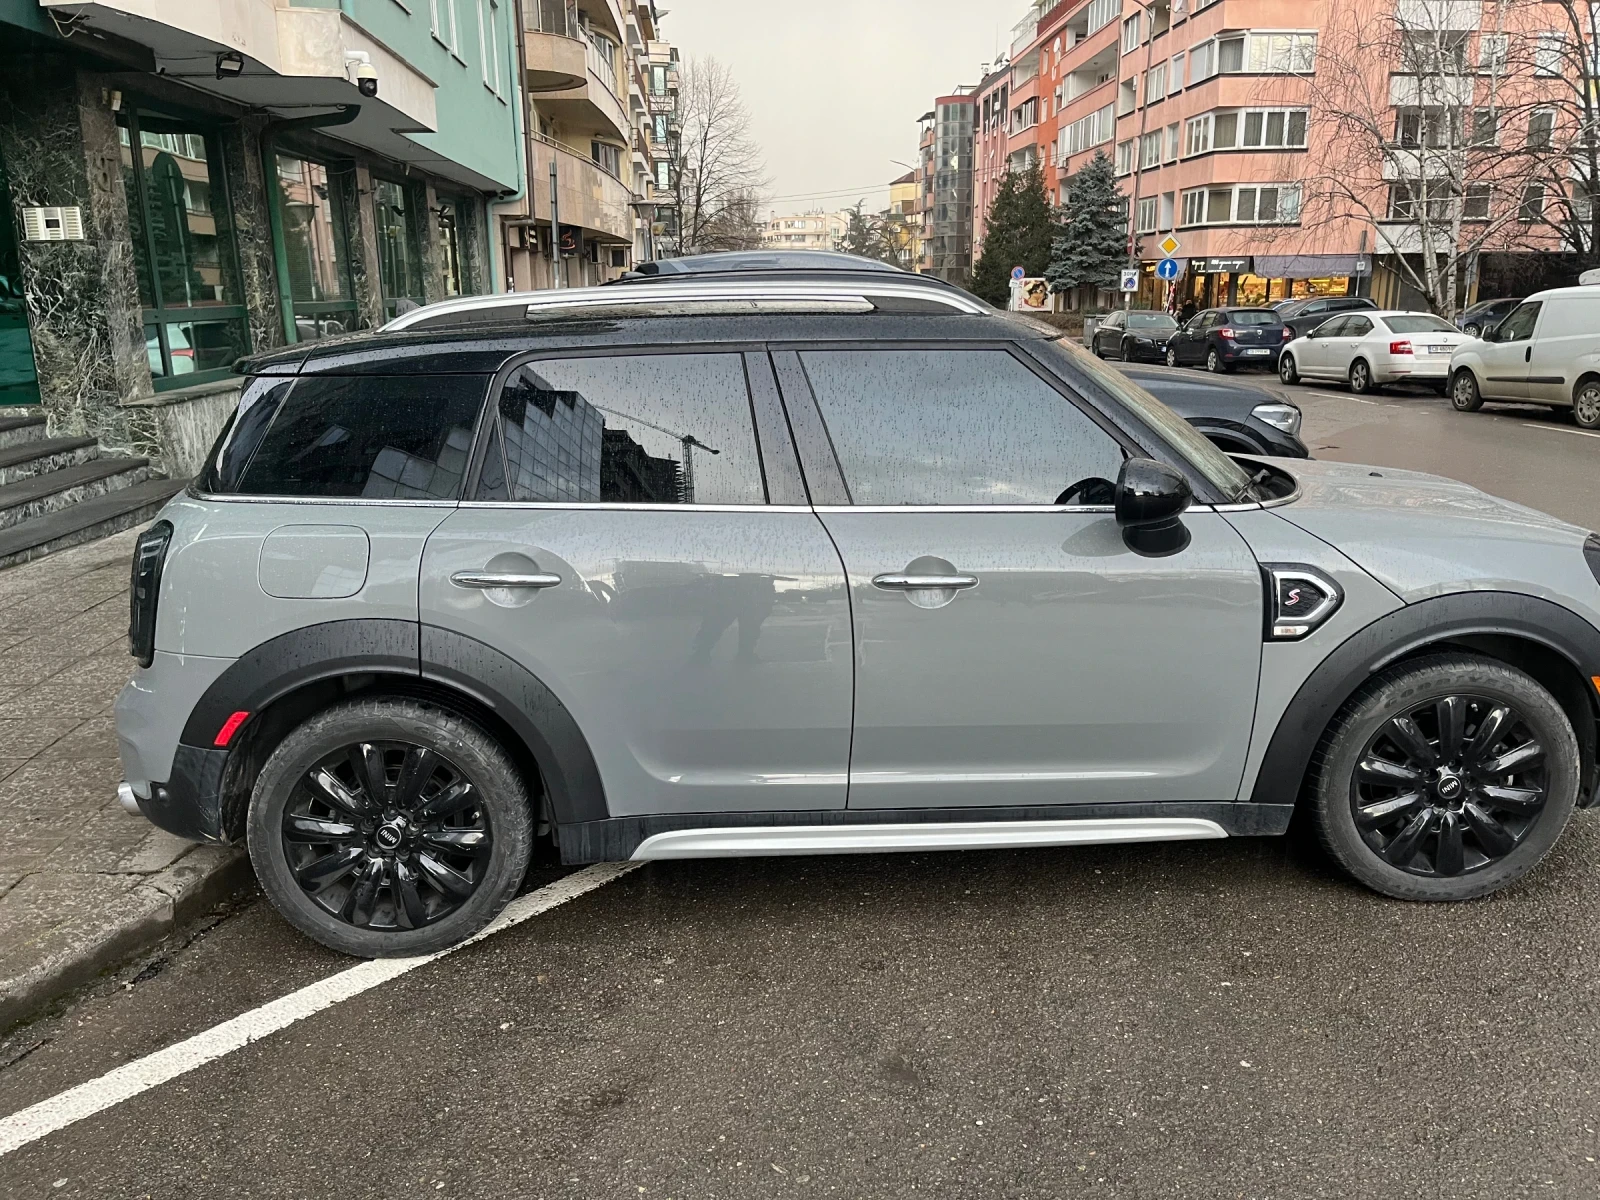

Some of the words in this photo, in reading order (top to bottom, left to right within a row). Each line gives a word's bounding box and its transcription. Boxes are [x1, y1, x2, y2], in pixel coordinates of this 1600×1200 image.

[1284, 588, 1301, 606] S
[1441, 780, 1459, 794] MINI
[380, 829, 398, 844] MINI
